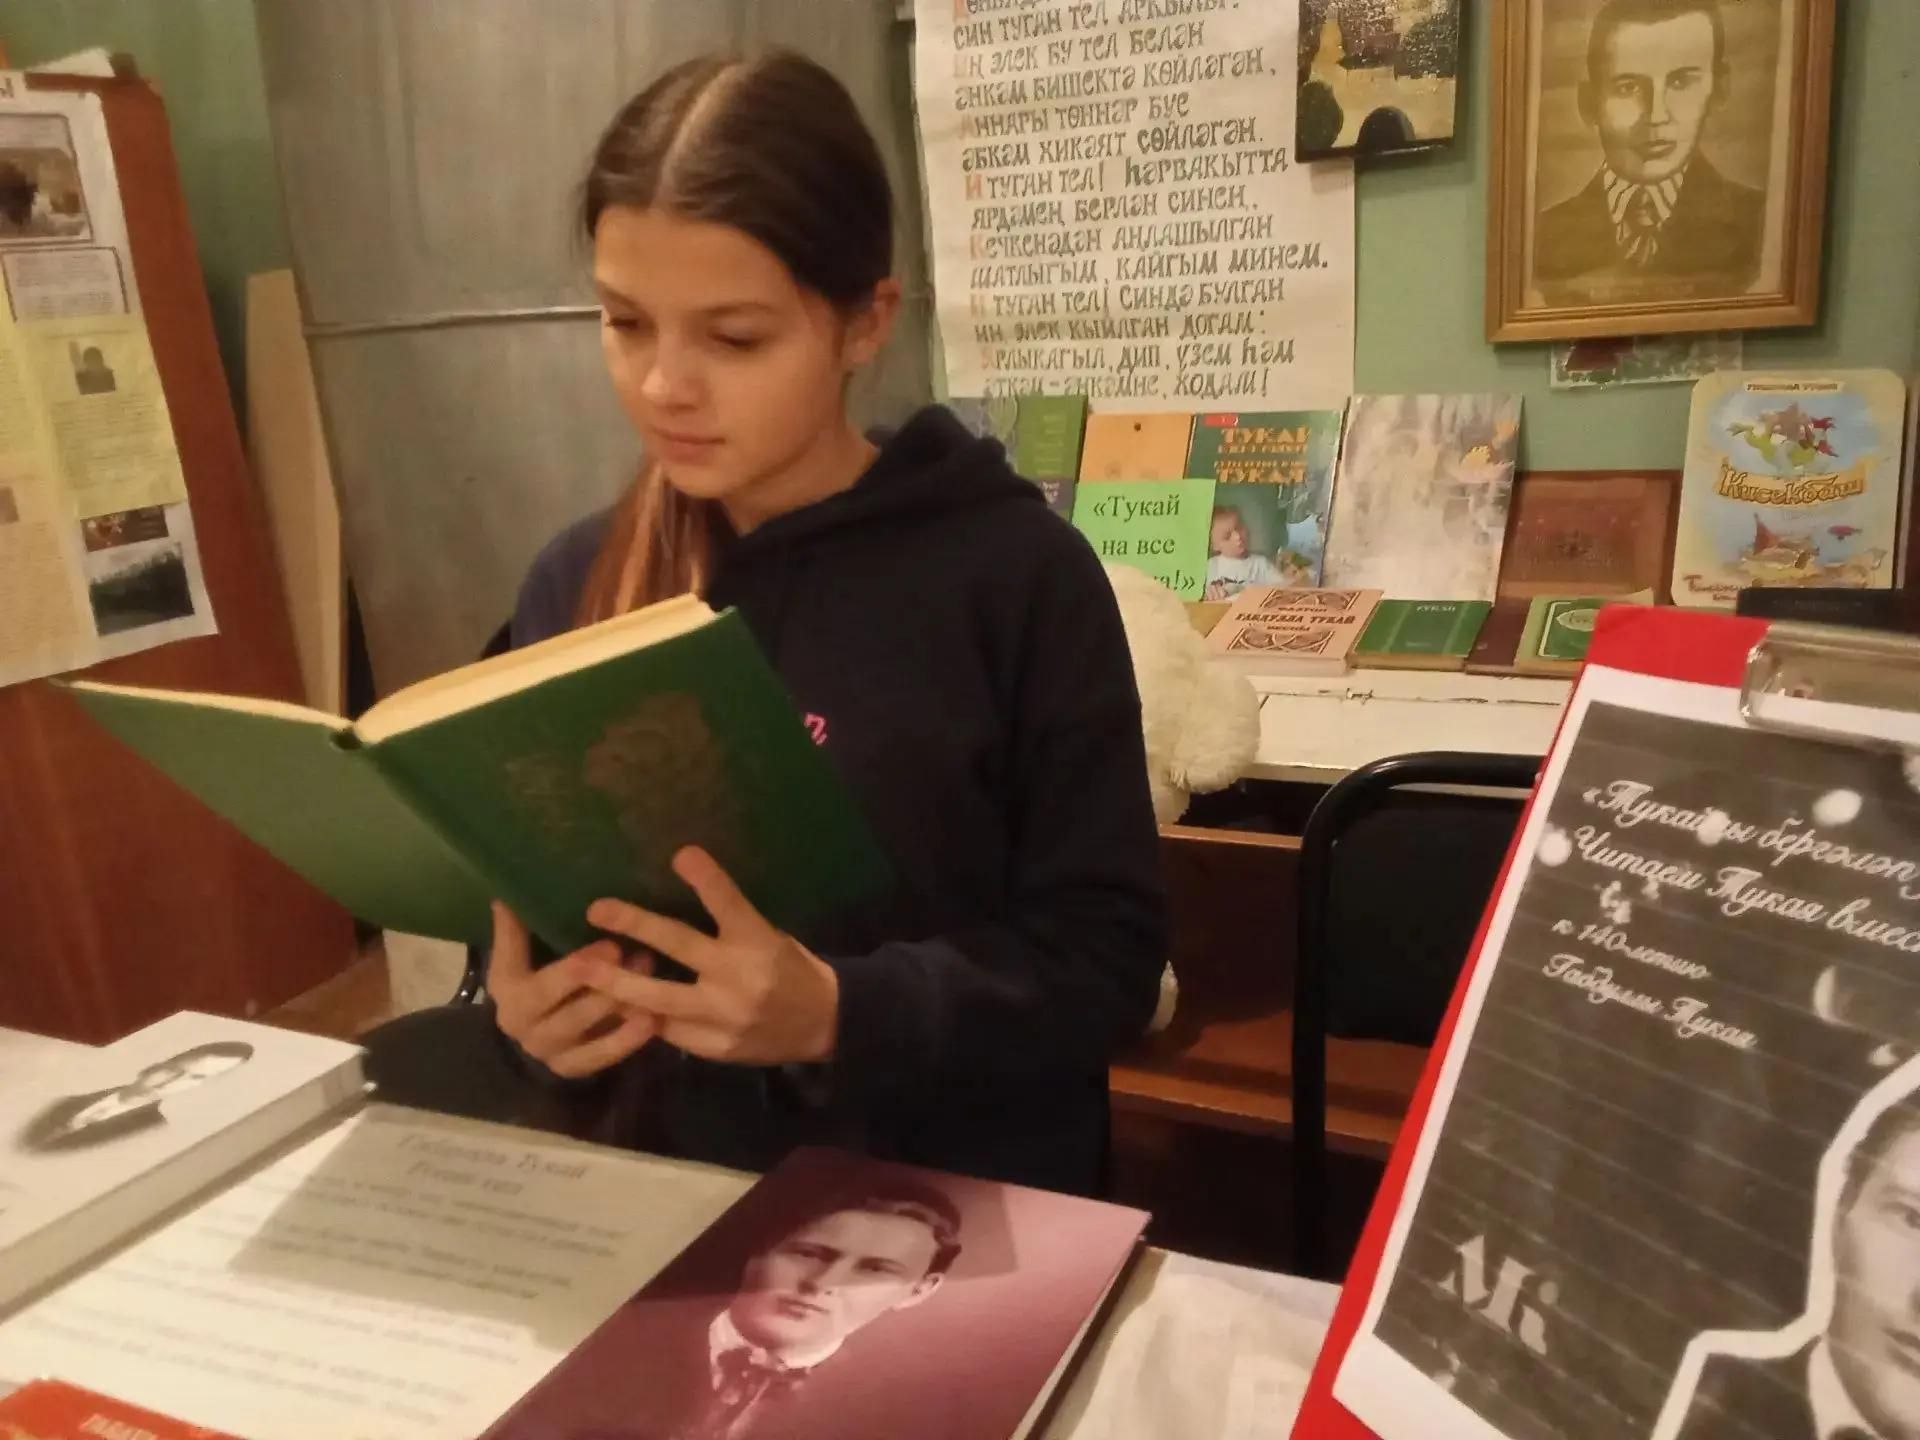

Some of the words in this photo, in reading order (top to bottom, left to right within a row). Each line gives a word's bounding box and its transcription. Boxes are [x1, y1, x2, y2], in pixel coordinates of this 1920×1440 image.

[1093, 495, 1180, 522] «Тукай
[1102, 539, 1128, 556] на
[1136, 537, 1176, 556] все
